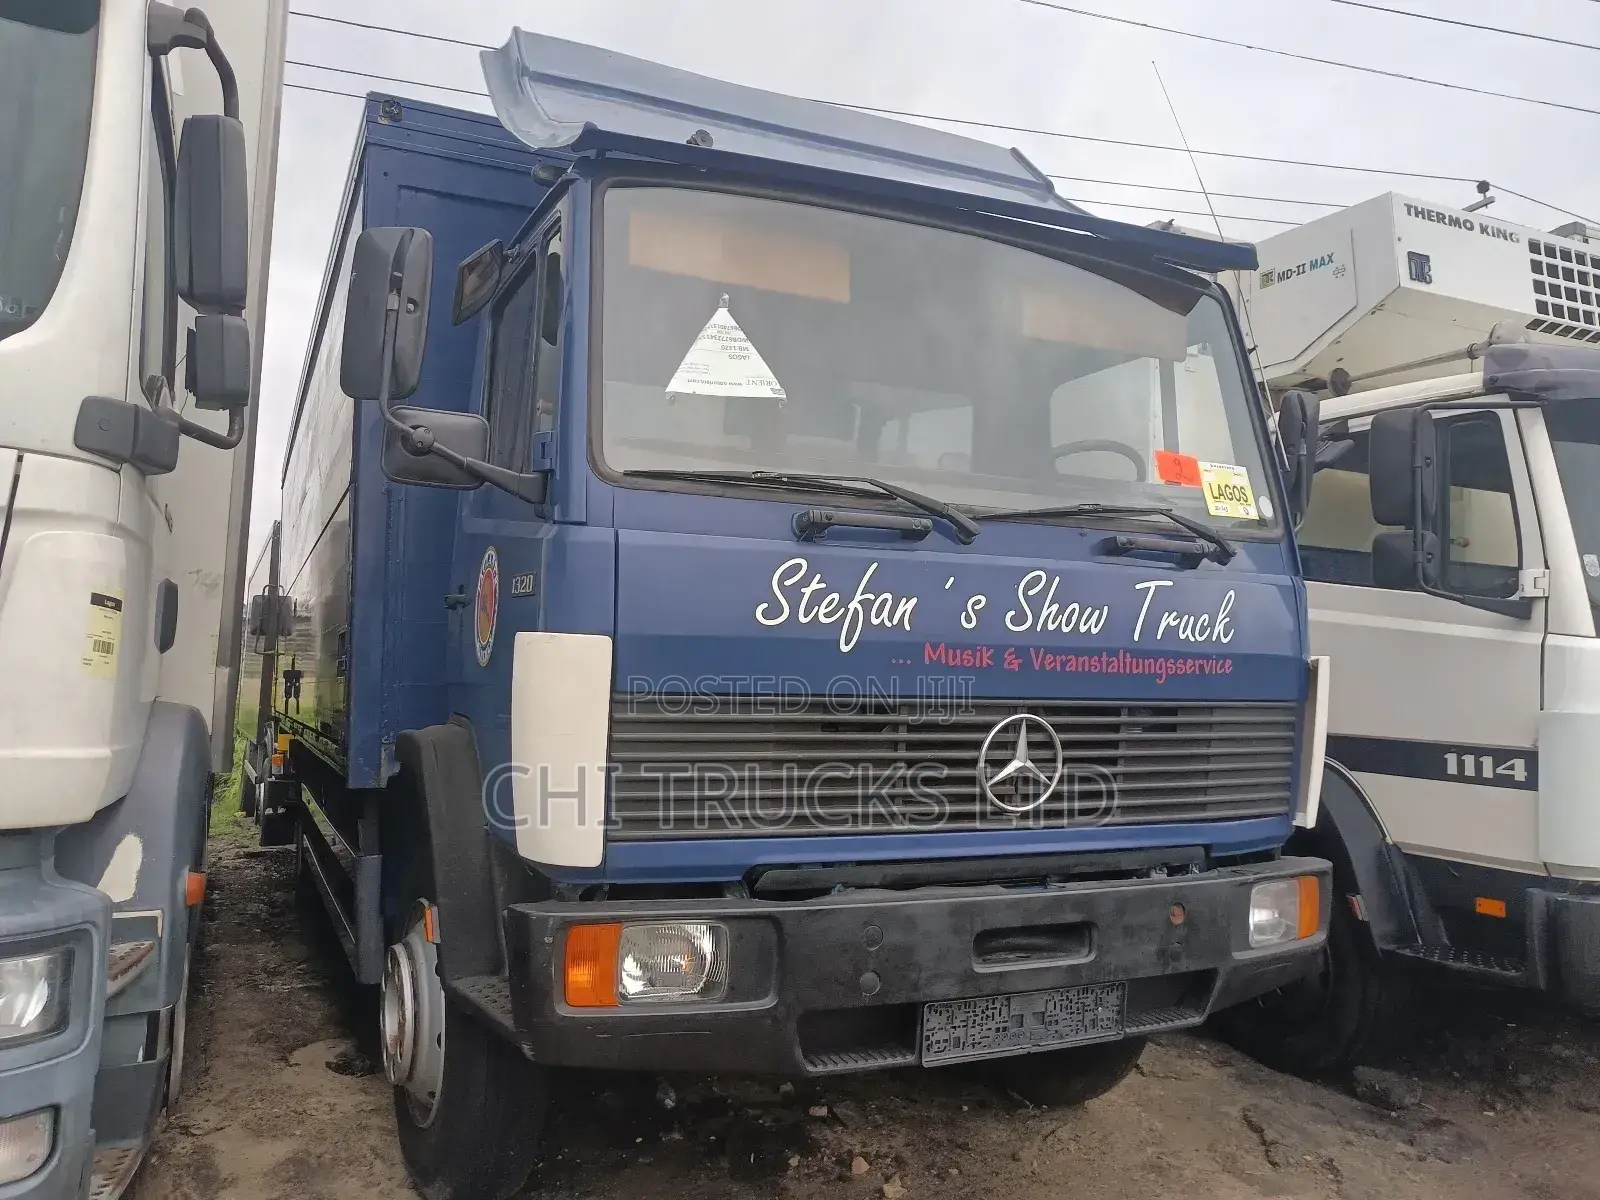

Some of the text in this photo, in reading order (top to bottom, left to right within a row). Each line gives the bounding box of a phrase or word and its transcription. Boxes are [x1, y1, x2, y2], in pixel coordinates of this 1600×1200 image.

[1403, 203, 1520, 244] THERMO KING
[1309, 252, 1334, 271] MAX
[1208, 482, 1249, 503] LAGOS
[511, 575, 534, 594] 1320
[754, 557, 919, 653] Stefan
[1004, 570, 1109, 634] Show
[1132, 579, 1236, 644] Truck
[923, 642, 994, 669] Musik
[1004, 648, 1020, 671] &
[1030, 647, 1233, 685] Veranstaltungsservice
[1444, 752, 1528, 782] 1114
